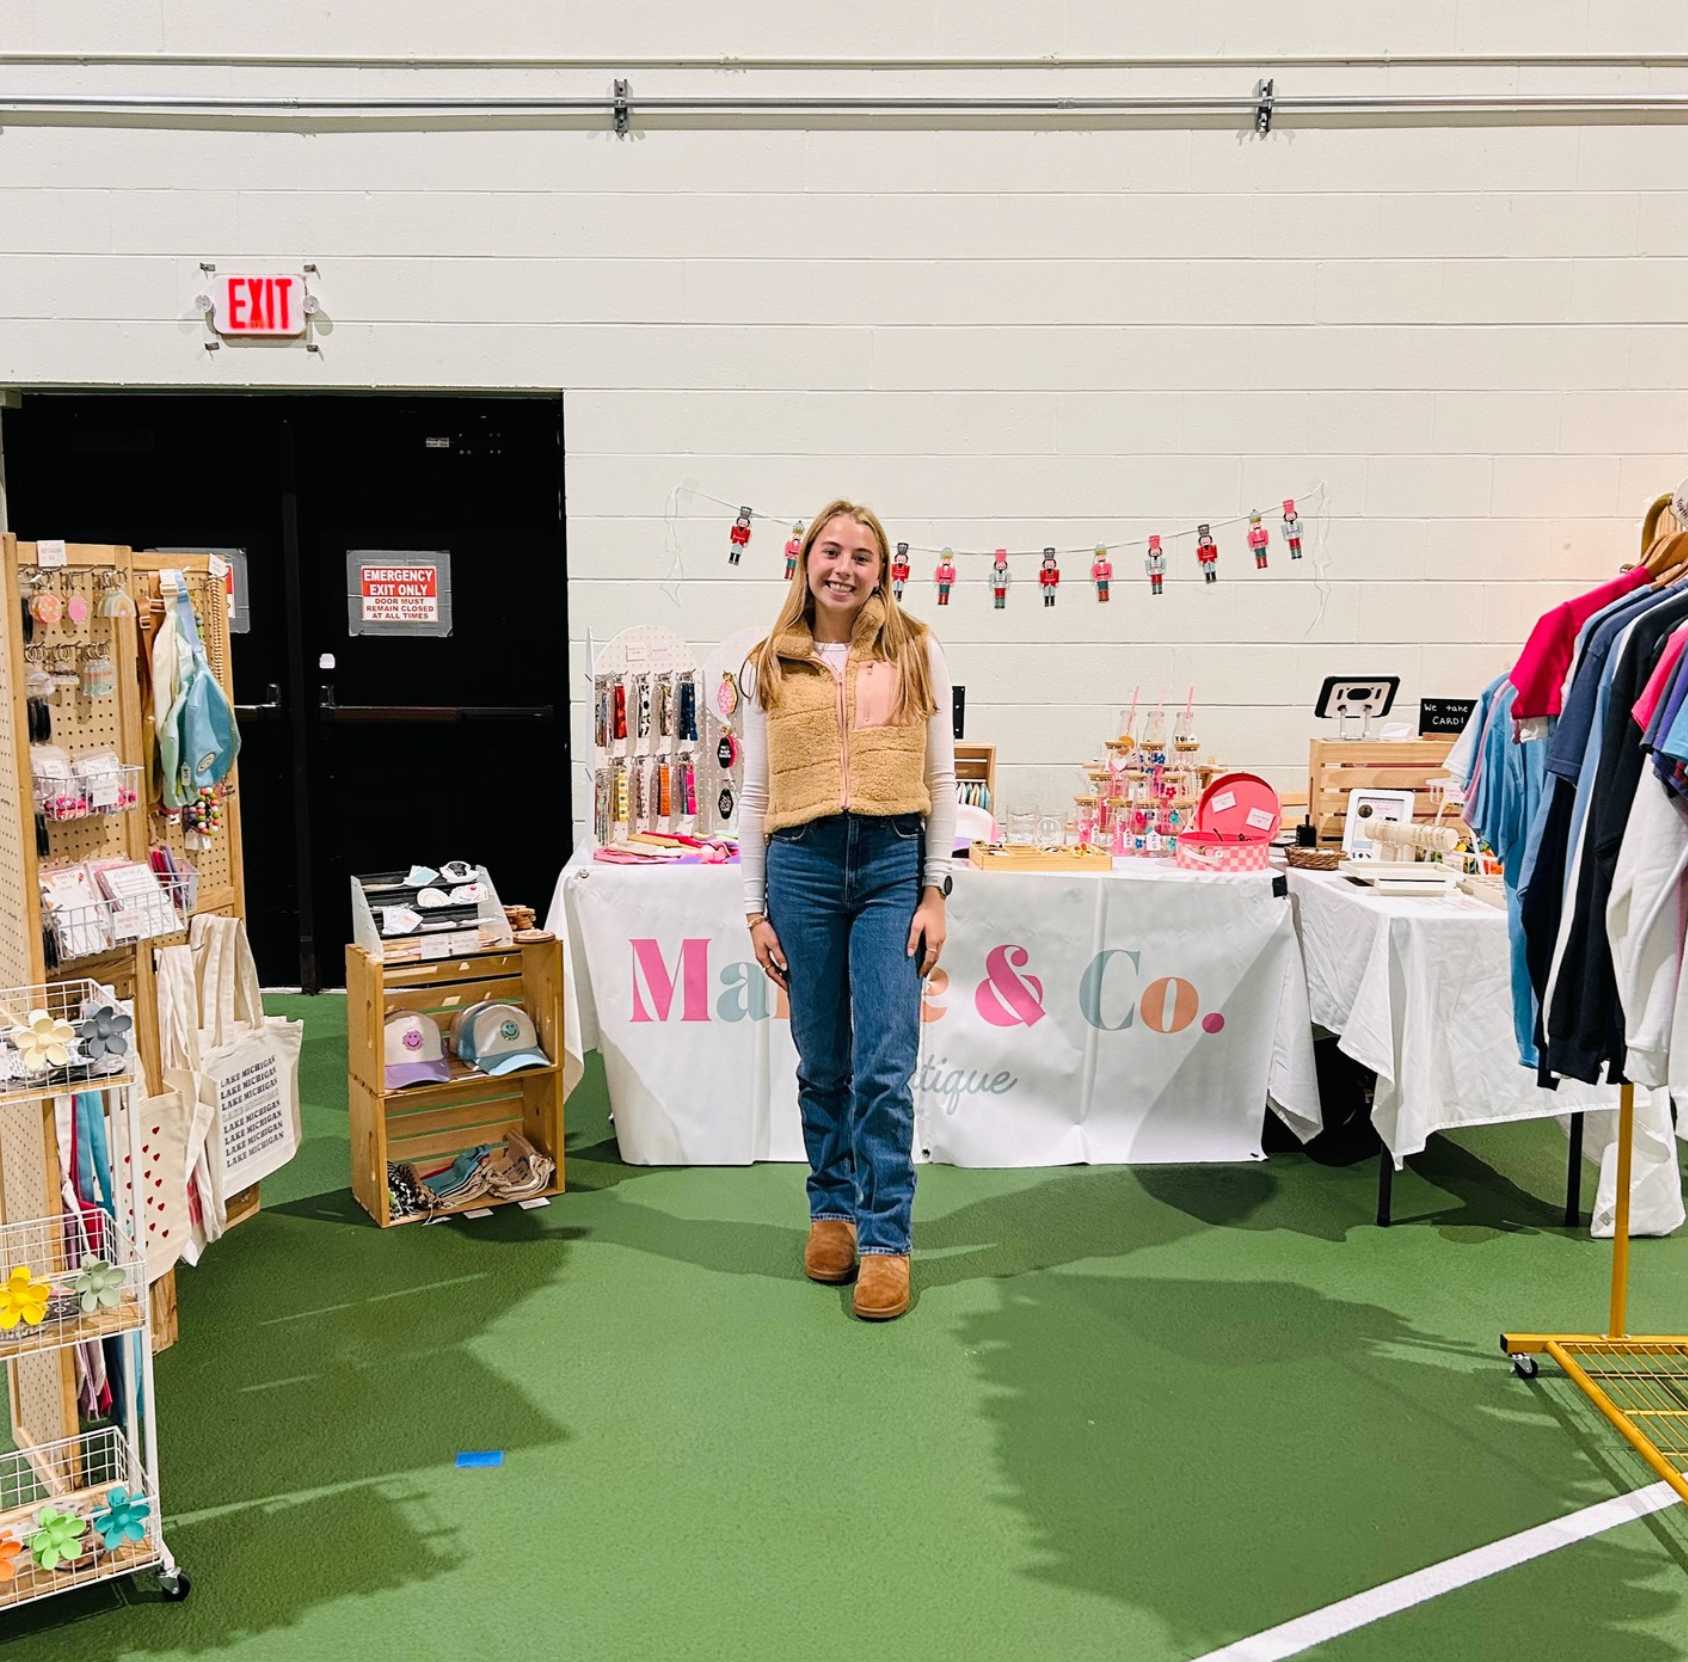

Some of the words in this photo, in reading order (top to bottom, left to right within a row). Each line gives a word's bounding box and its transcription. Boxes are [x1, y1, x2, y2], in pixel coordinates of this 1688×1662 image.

[228, 278, 292, 329] EXIT
[364, 570, 433, 582] EMERGENCY
[369, 584, 395, 596] EXIT
[398, 584, 428, 596] ONLY
[1424, 703, 1437, 712] We
[1432, 715, 1464, 725] CARD!
[629, 938, 949, 1024] Mae
[975, 944, 1047, 1028] &
[1079, 949, 1226, 1035] Co.
[220, 1072, 241, 1088] LAKE
[241, 1055, 276, 1078] MICHIGAN
[220, 1084, 241, 1100] LAKE
[242, 1066, 277, 1090] MICHIGAN
[909, 1054, 1018, 1116] tique
[221, 1095, 243, 1111] LAKE
[243, 1077, 278, 1100] MICHIGAN
[223, 1118, 245, 1134] LAKE
[245, 1099, 281, 1123] MICHIGAN
[224, 1129, 246, 1145] LAKE
[246, 1109, 282, 1134] MICHIGAN
[225, 1140, 246, 1157] LAKE
[247, 1120, 283, 1145] MICHIGAN
[226, 1151, 247, 1168] LAKE
[248, 1131, 284, 1156] MICHIGAN
